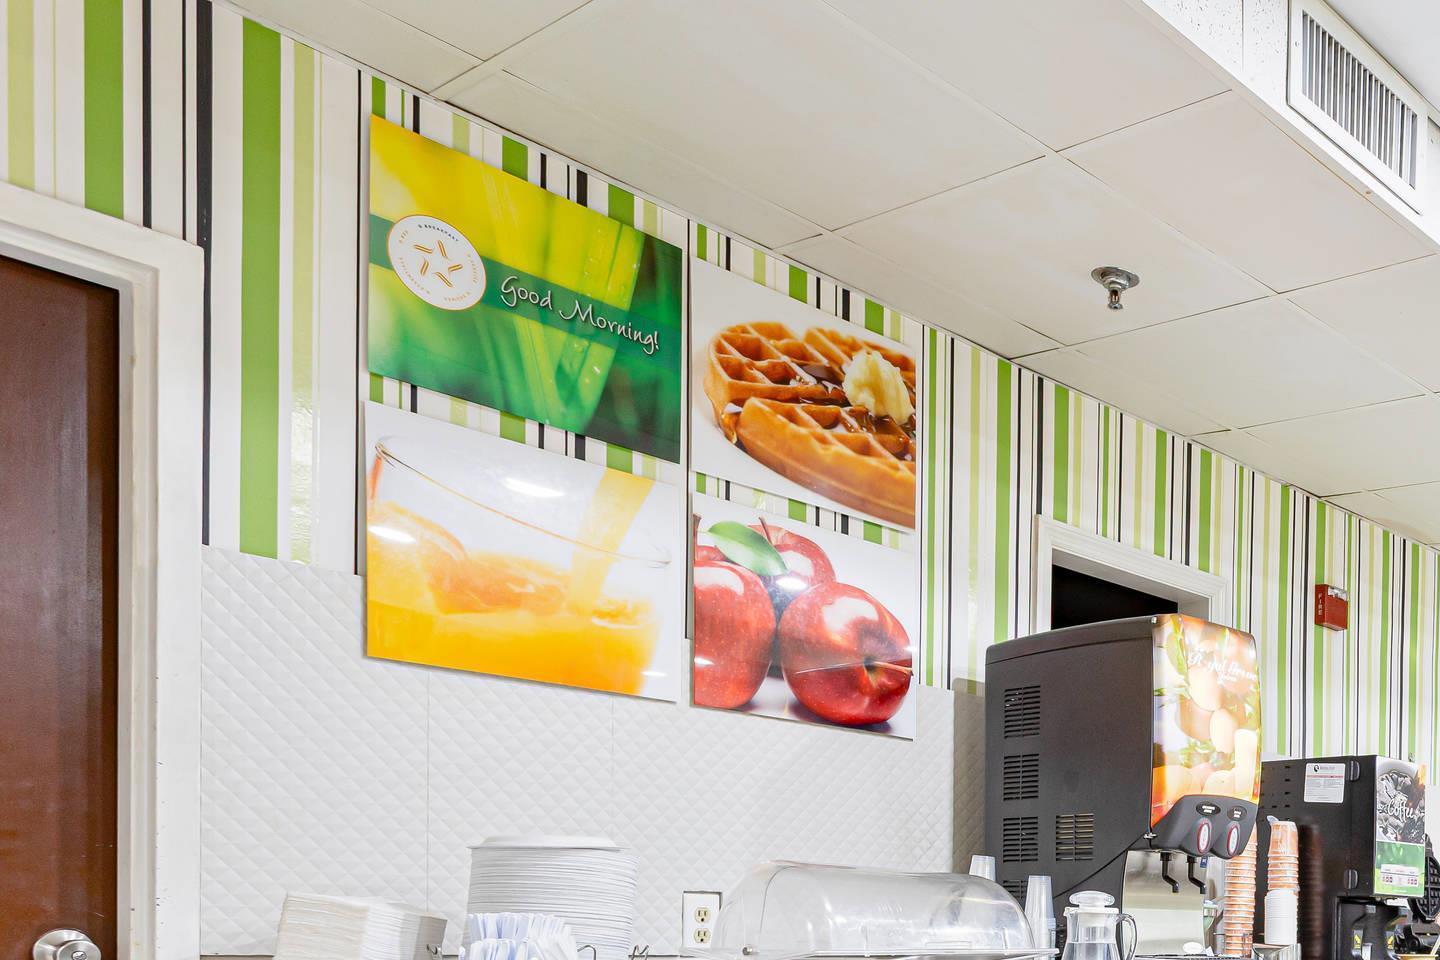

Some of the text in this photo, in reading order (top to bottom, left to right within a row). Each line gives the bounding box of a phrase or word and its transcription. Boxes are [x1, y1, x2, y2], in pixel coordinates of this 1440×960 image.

[500, 275, 660, 356] Good Morning!
[1387, 798, 1416, 823] Coffee
